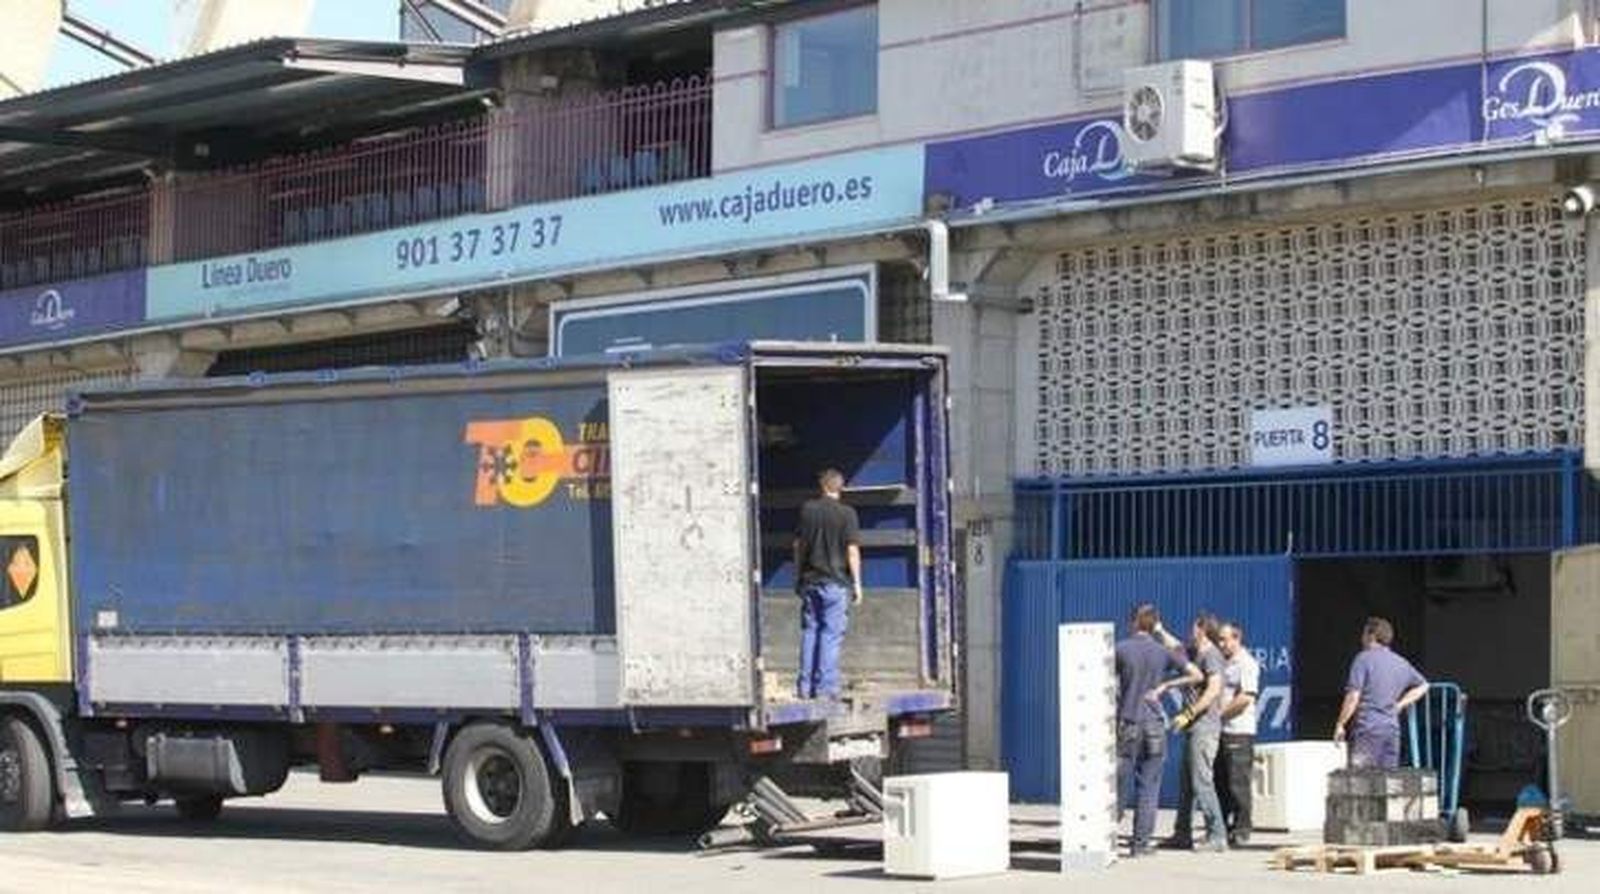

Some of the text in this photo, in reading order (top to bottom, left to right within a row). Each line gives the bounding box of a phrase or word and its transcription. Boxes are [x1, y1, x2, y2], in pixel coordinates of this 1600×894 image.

[659, 176, 872, 225] www.cajaduero.es
[397, 215, 562, 269] 901 37 37 37
[247, 257, 292, 282] Duero
[578, 422, 609, 441] TRA
[1254, 421, 1329, 450] PUERTA 8
